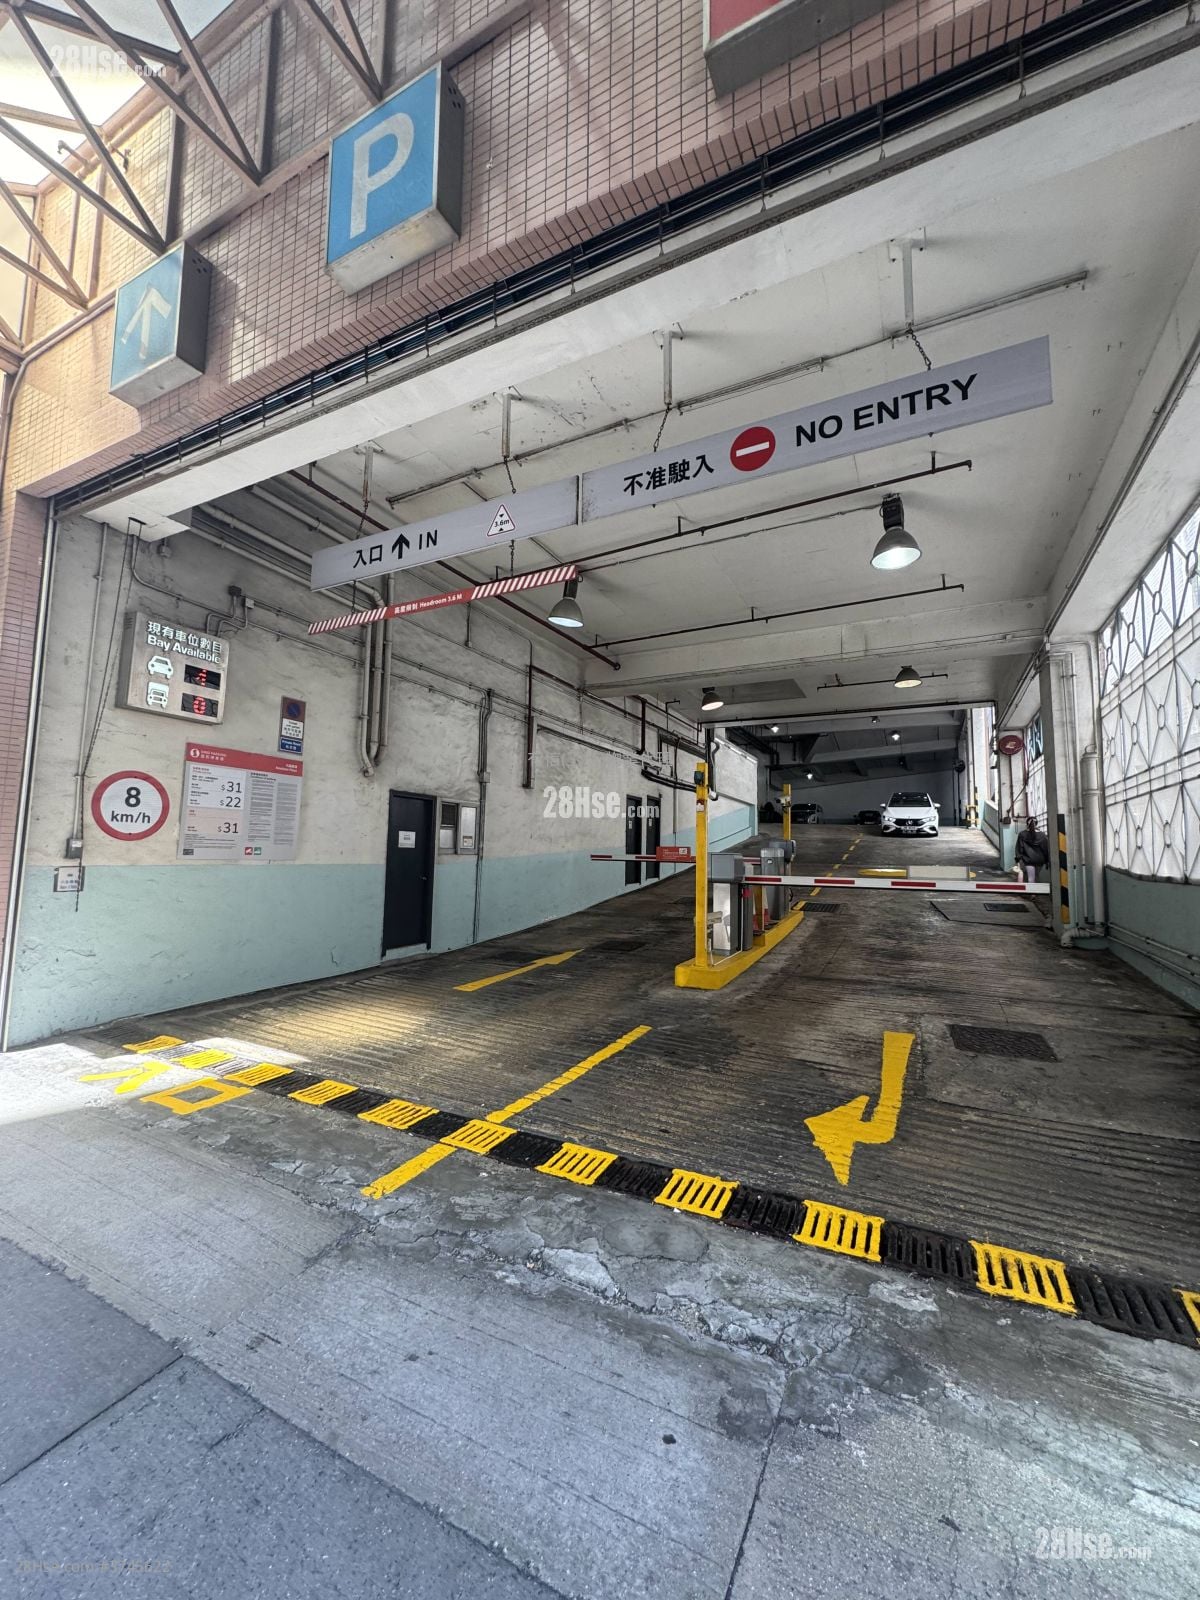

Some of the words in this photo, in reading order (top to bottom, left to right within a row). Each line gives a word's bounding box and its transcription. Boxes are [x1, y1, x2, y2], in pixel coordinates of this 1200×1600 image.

[349, 112, 414, 240] P
[796, 415, 843, 447] NO
[853, 373, 978, 431] ENTRY
[623, 454, 714, 496] 不准駛入
[494, 519, 510, 528] 3.6m
[418, 529, 438, 550] IN
[352, 544, 383, 569] 入口
[419, 597, 447, 609] Headroom
[146, 620, 222, 653] 現有車位數目
[147, 634, 171, 652] Bay
[172, 642, 221, 664] Available
[125, 786, 141, 808] 8
[110, 810, 151, 824] km/h
